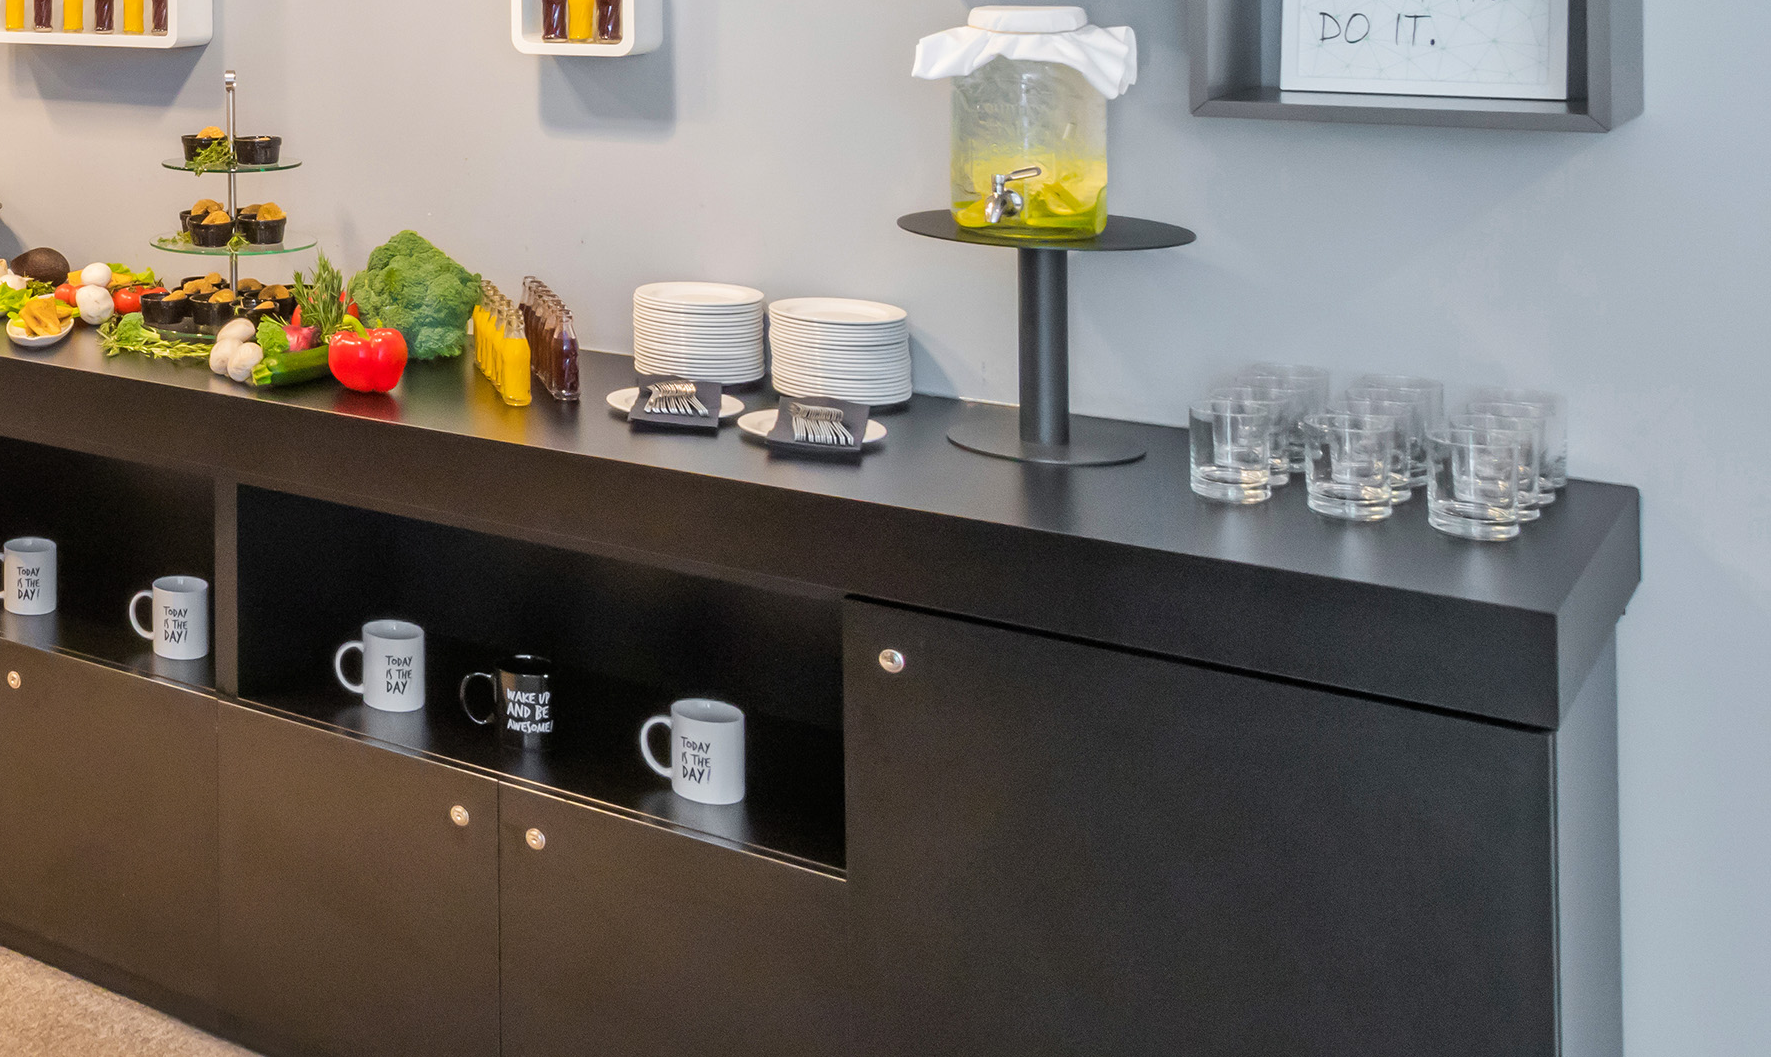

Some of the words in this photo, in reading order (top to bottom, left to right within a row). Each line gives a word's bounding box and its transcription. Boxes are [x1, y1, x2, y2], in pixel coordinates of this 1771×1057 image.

[1319, 12, 1370, 44] DO
[1395, 13, 1435, 46] IT.
[16, 566, 40, 576] TODAY
[25, 578, 40, 588] THE
[163, 606, 188, 618] TODAY
[172, 619, 188, 630] THE
[385, 655, 413, 667] TODAY
[385, 668, 392, 680] IS
[395, 669, 412, 680] THE
[506, 687, 536, 704] WAKE
[538, 691, 550, 705] UP
[506, 701, 531, 719] AND
[535, 704, 549, 721] BE
[506, 718, 554, 733] AWESOME!
[680, 735, 711, 754] TODAY
[690, 753, 711, 769] THE
[682, 764, 711, 784] DAY!
